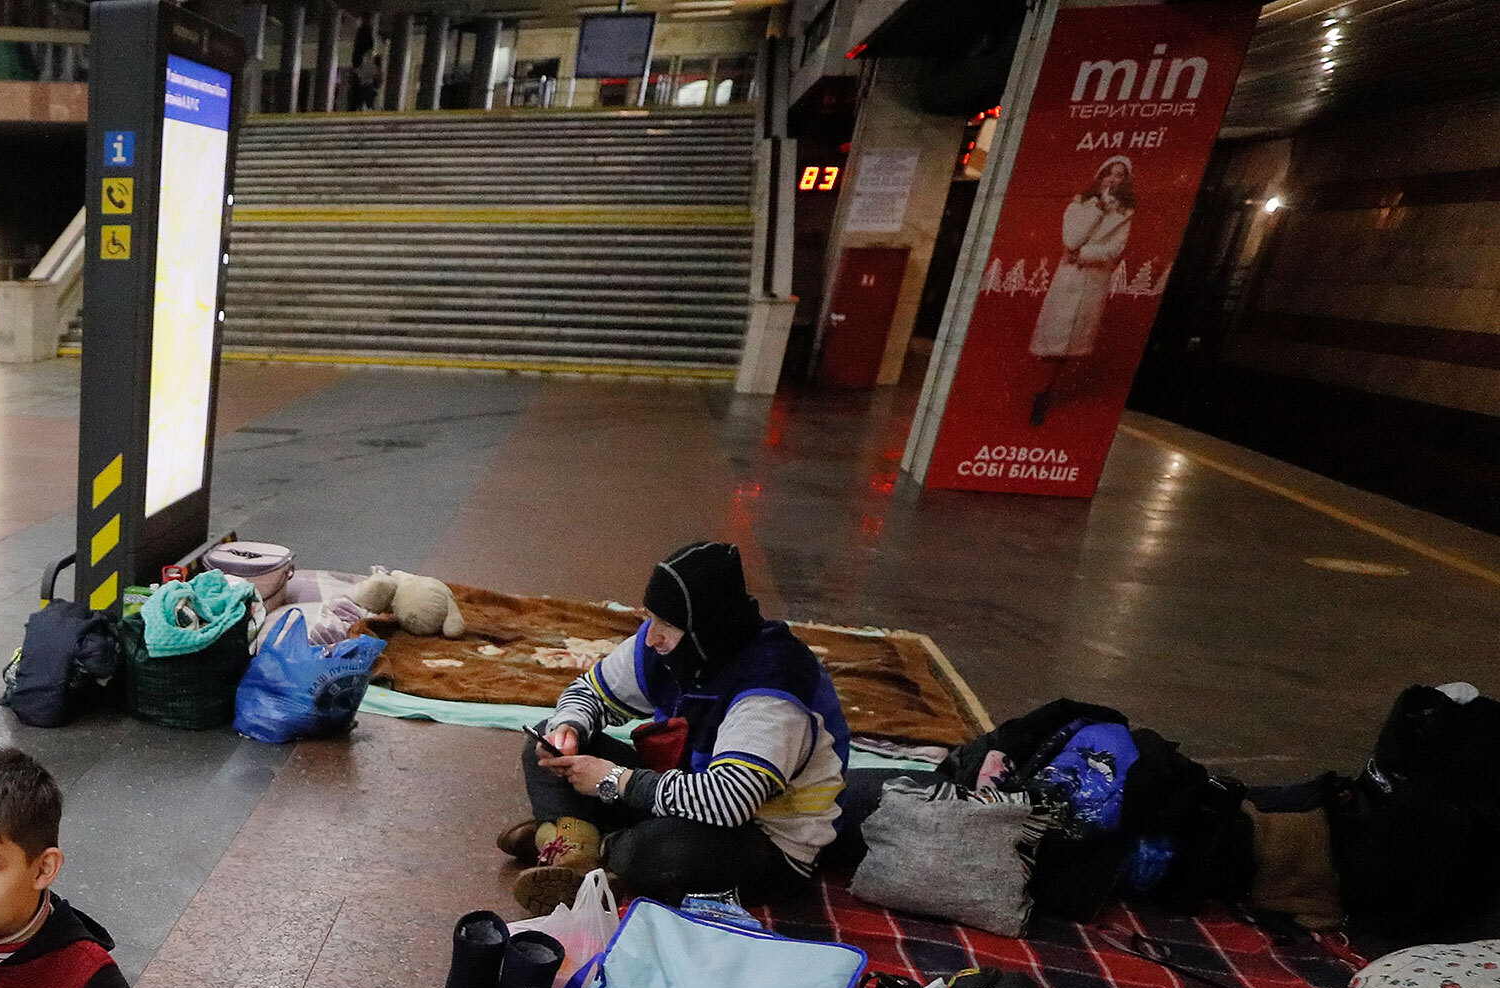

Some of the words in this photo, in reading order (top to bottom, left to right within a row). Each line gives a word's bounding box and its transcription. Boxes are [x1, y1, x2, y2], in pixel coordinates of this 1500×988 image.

[1070, 43, 1209, 102] min
[1068, 102, 1198, 119] ТЕРИТОРІЯ
[1076, 130, 1124, 151] ДЛЯ
[1128, 127, 1168, 149] НЕЇ
[799, 166, 840, 191] 83
[974, 444, 1069, 464] ДОЗВОЛЬ
[957, 460, 1005, 477] СОБІ
[1008, 463, 1080, 482] БІЛЬШЕ
